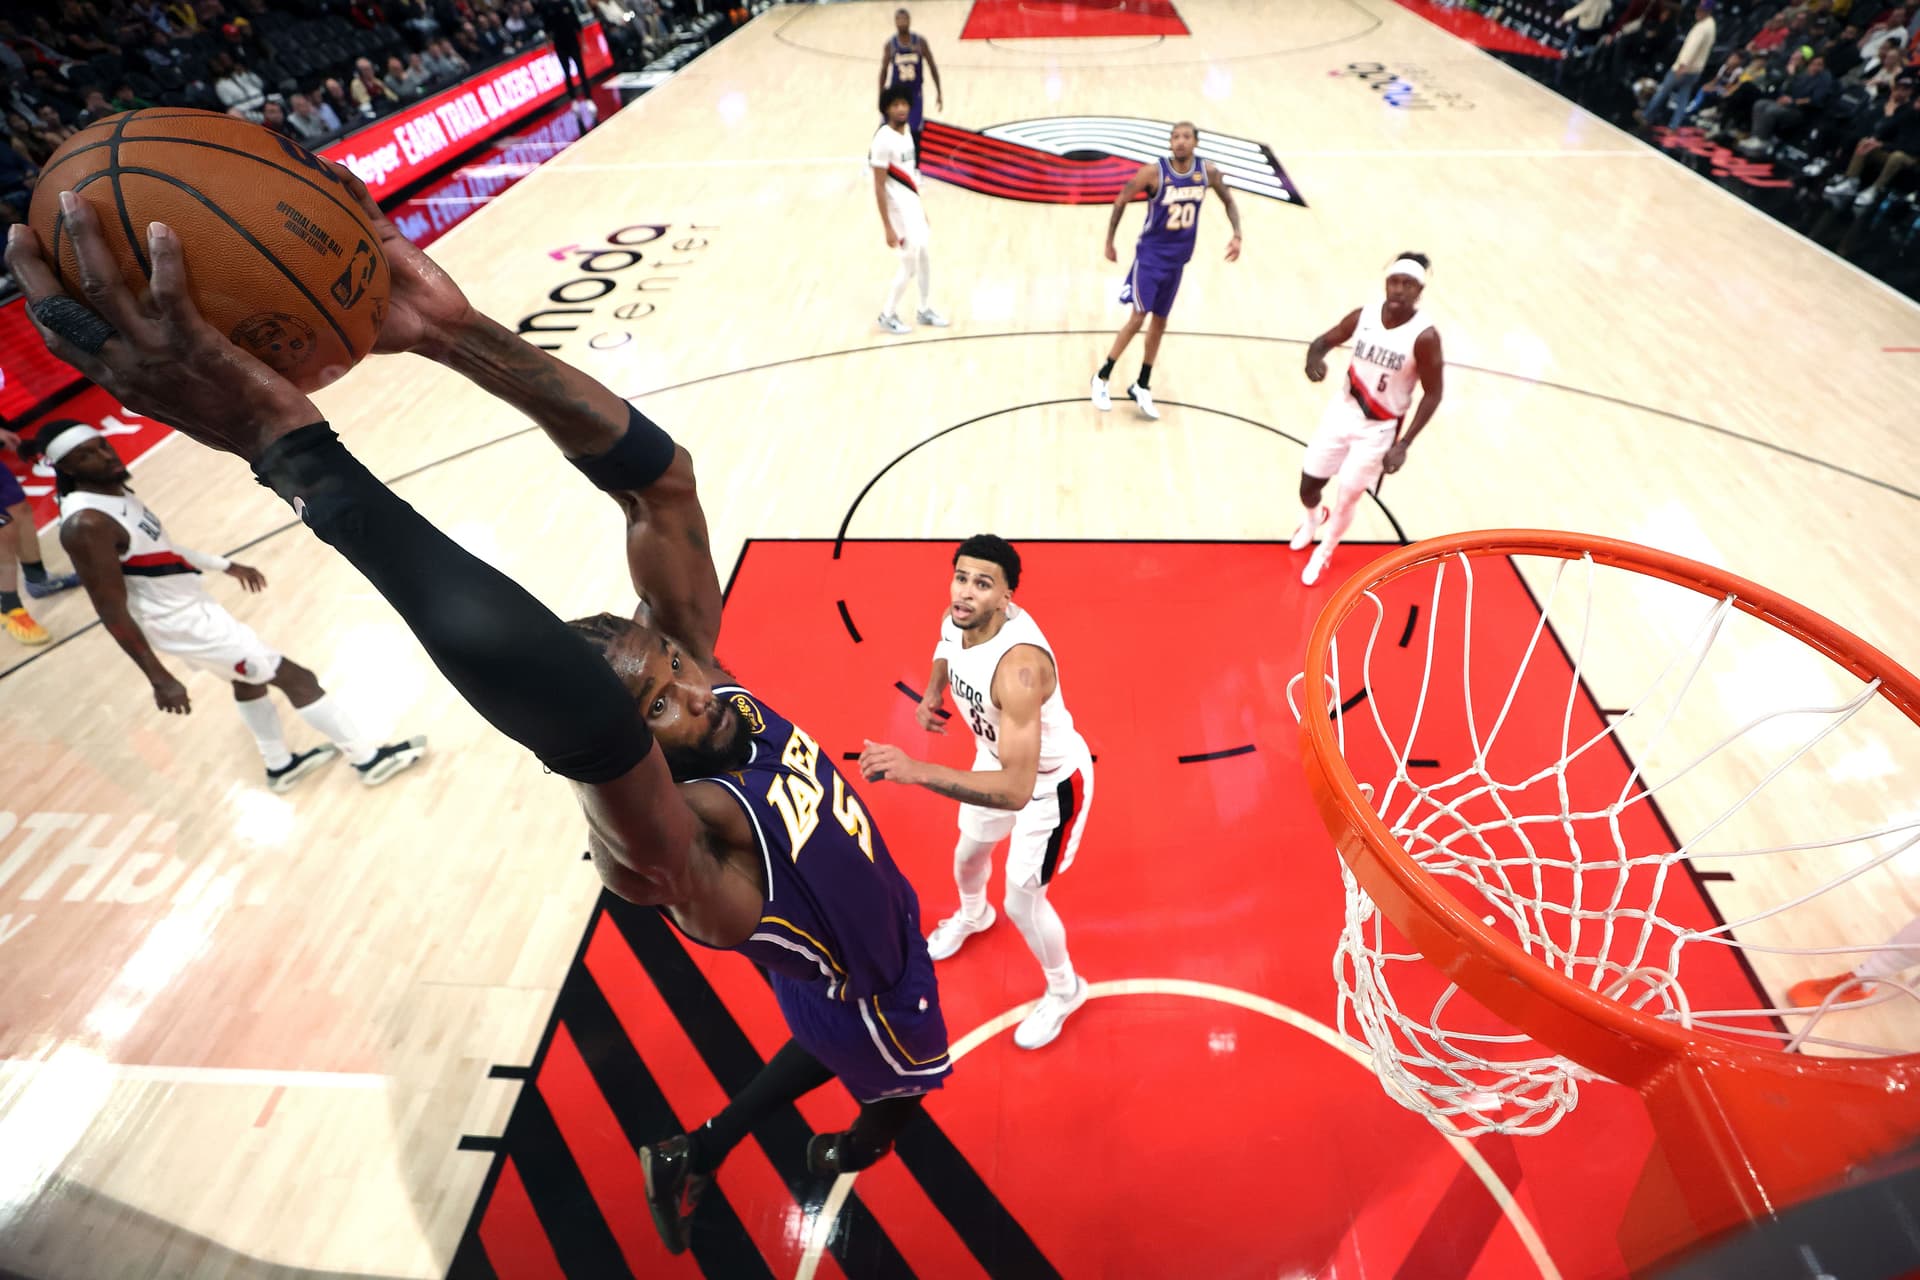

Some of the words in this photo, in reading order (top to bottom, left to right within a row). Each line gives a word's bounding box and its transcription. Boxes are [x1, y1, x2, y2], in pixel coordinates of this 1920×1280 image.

[393, 111, 449, 166] EARN
[435, 91, 488, 142] TRAIL
[478, 65, 537, 121] BLAZERS
[1166, 202, 1196, 230] 20
[1354, 339, 1406, 371] BLAZERS
[1377, 373, 1390, 393] 5
[969, 707, 996, 742] 33
[832, 768, 875, 864] 5
